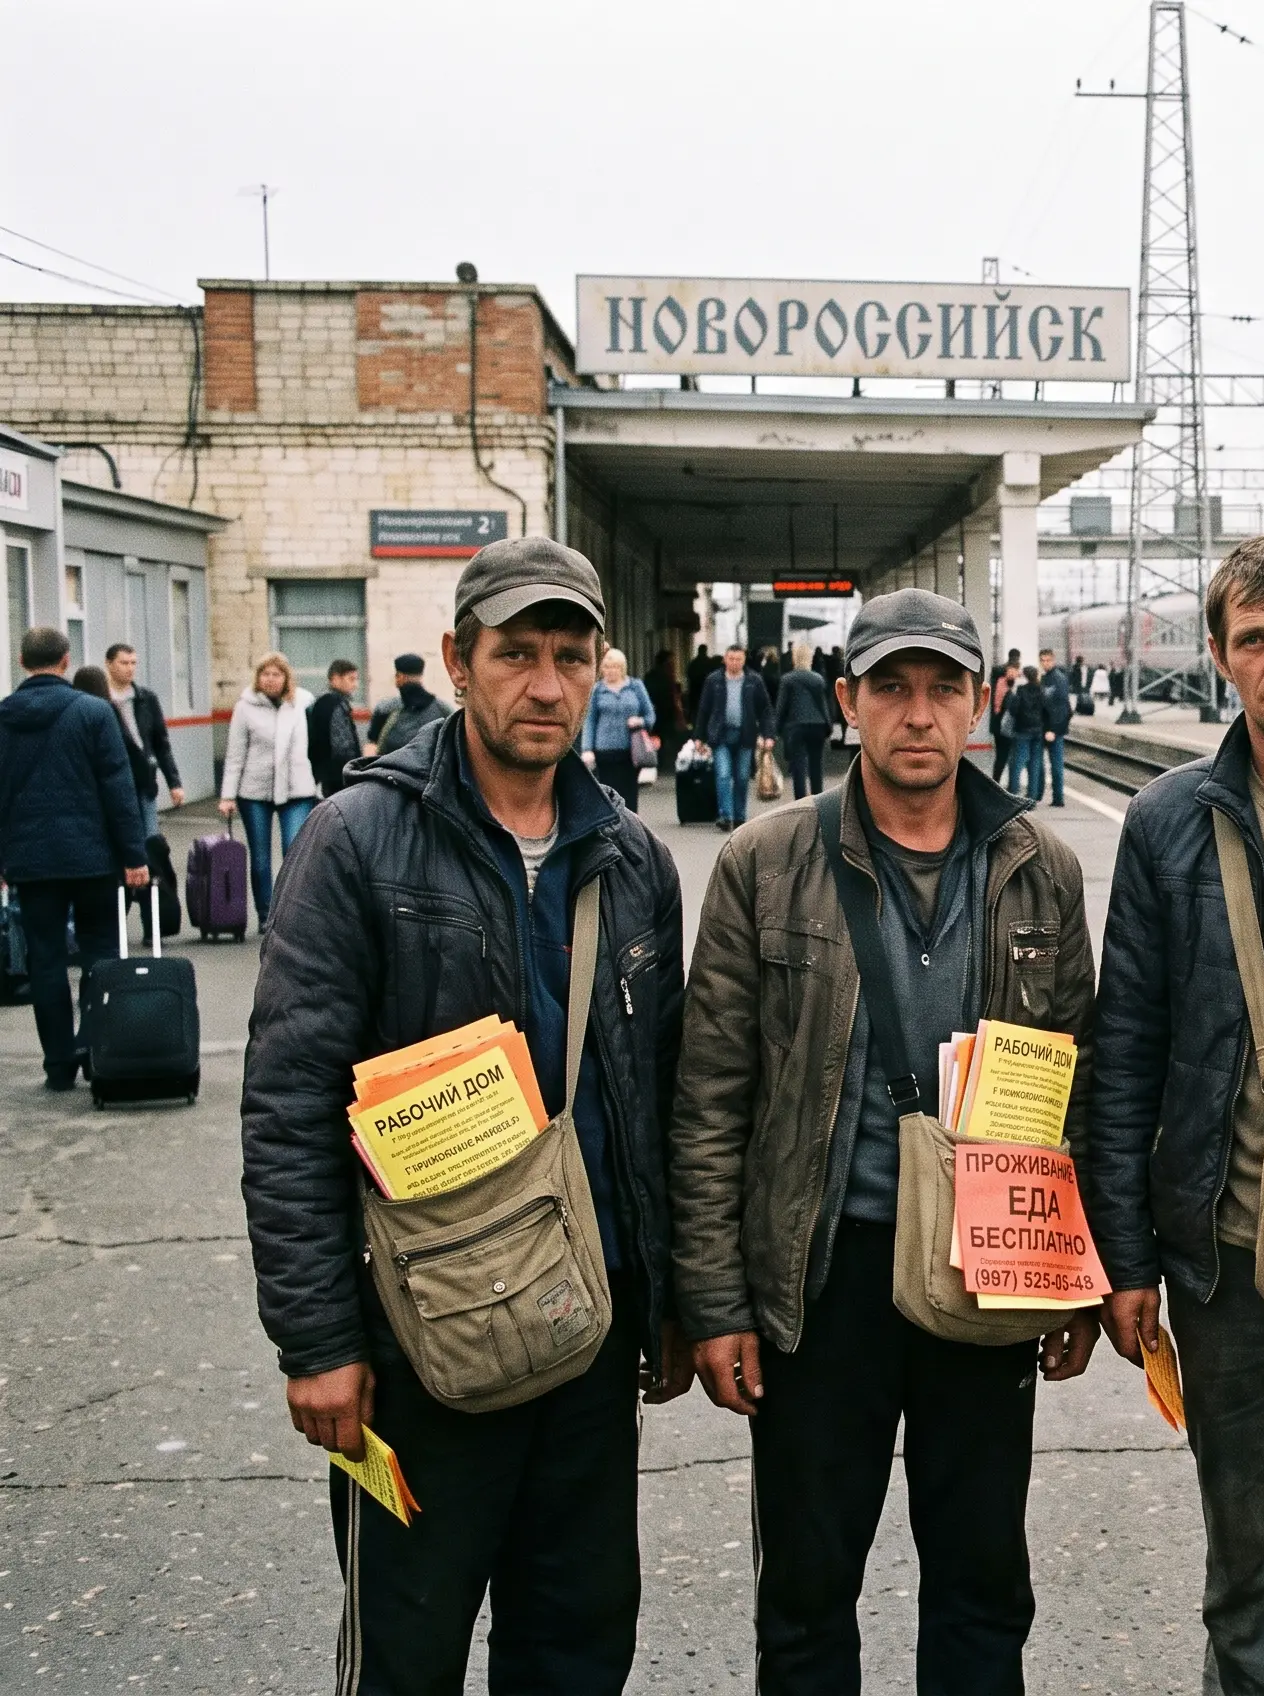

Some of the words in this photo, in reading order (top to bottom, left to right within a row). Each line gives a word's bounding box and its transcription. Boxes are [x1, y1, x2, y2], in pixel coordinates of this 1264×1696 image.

[605, 289, 1106, 362] НОВОРОССИЙСК
[478, 515, 490, 534] 2
[994, 1036, 1053, 1062] РАБОЧИЙ
[374, 1082, 462, 1136] РАБОЧИЙ
[464, 1064, 505, 1100] ДОМ
[965, 1152, 1074, 1184] ПРОЖИВАНИЕ
[1009, 1185, 1061, 1223] ЕДА
[970, 1226, 1087, 1256] БЕСПЛАТНО
